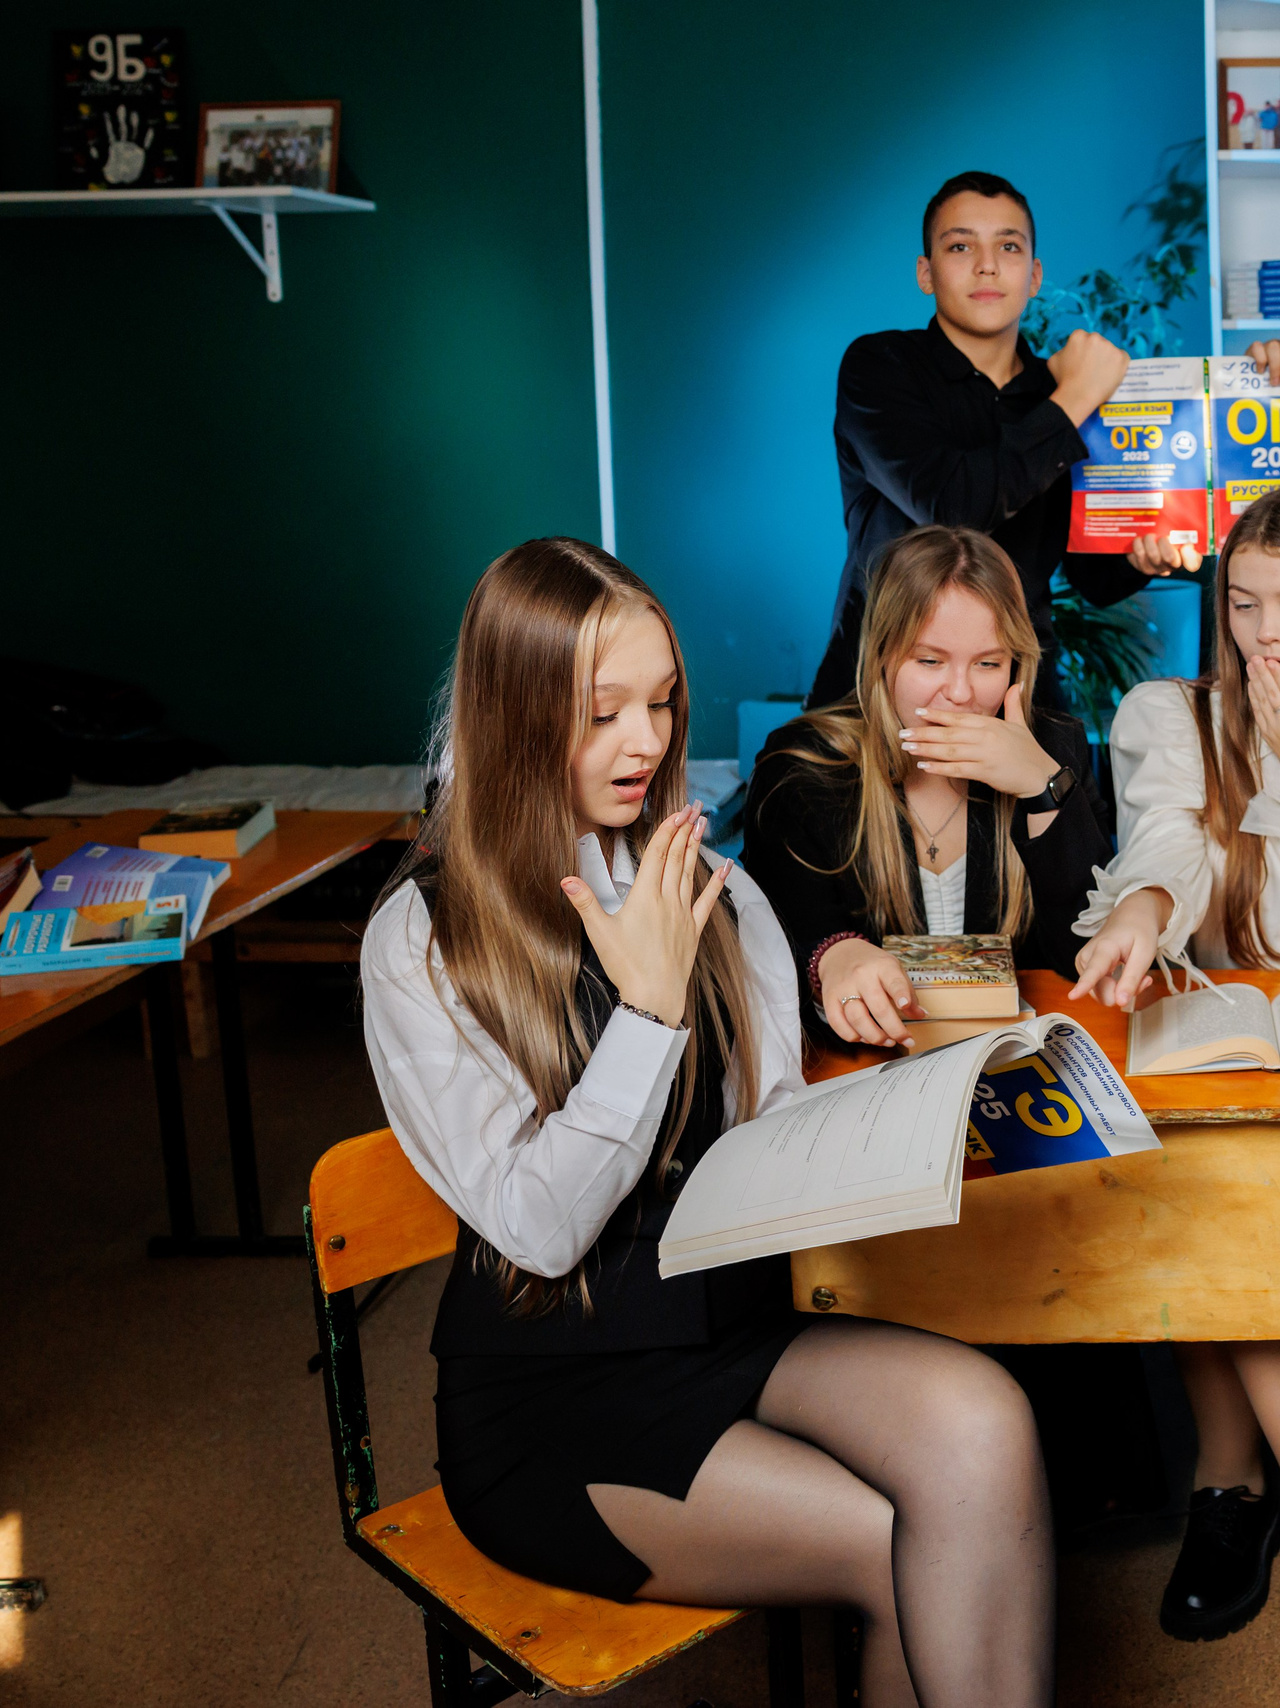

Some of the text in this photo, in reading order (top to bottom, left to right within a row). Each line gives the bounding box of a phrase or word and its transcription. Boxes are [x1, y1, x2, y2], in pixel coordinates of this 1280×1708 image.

[87, 33, 147, 82] 9Б
[1240, 377, 1261, 390] 20
[1104, 403, 1168, 414] РУССКИЙ ЯЗЫК
[1111, 426, 1163, 449] ОГЭ
[1122, 451, 1150, 462] 2025
[1053, 1040, 1088, 1078] ВАРИАНТОВ
[1066, 1037, 1115, 1096] СОБЕСЕДОВАНИЯ
[1075, 1035, 1137, 1117] ВАРИАНТОВ ИТОГОВОГО
[972, 1083, 1011, 1120] 25
[985, 1055, 1083, 1137] ГЭ
[1045, 1043, 1116, 1137] ЭКЗАМЕНАЦИОННЫХ РАБОТ
